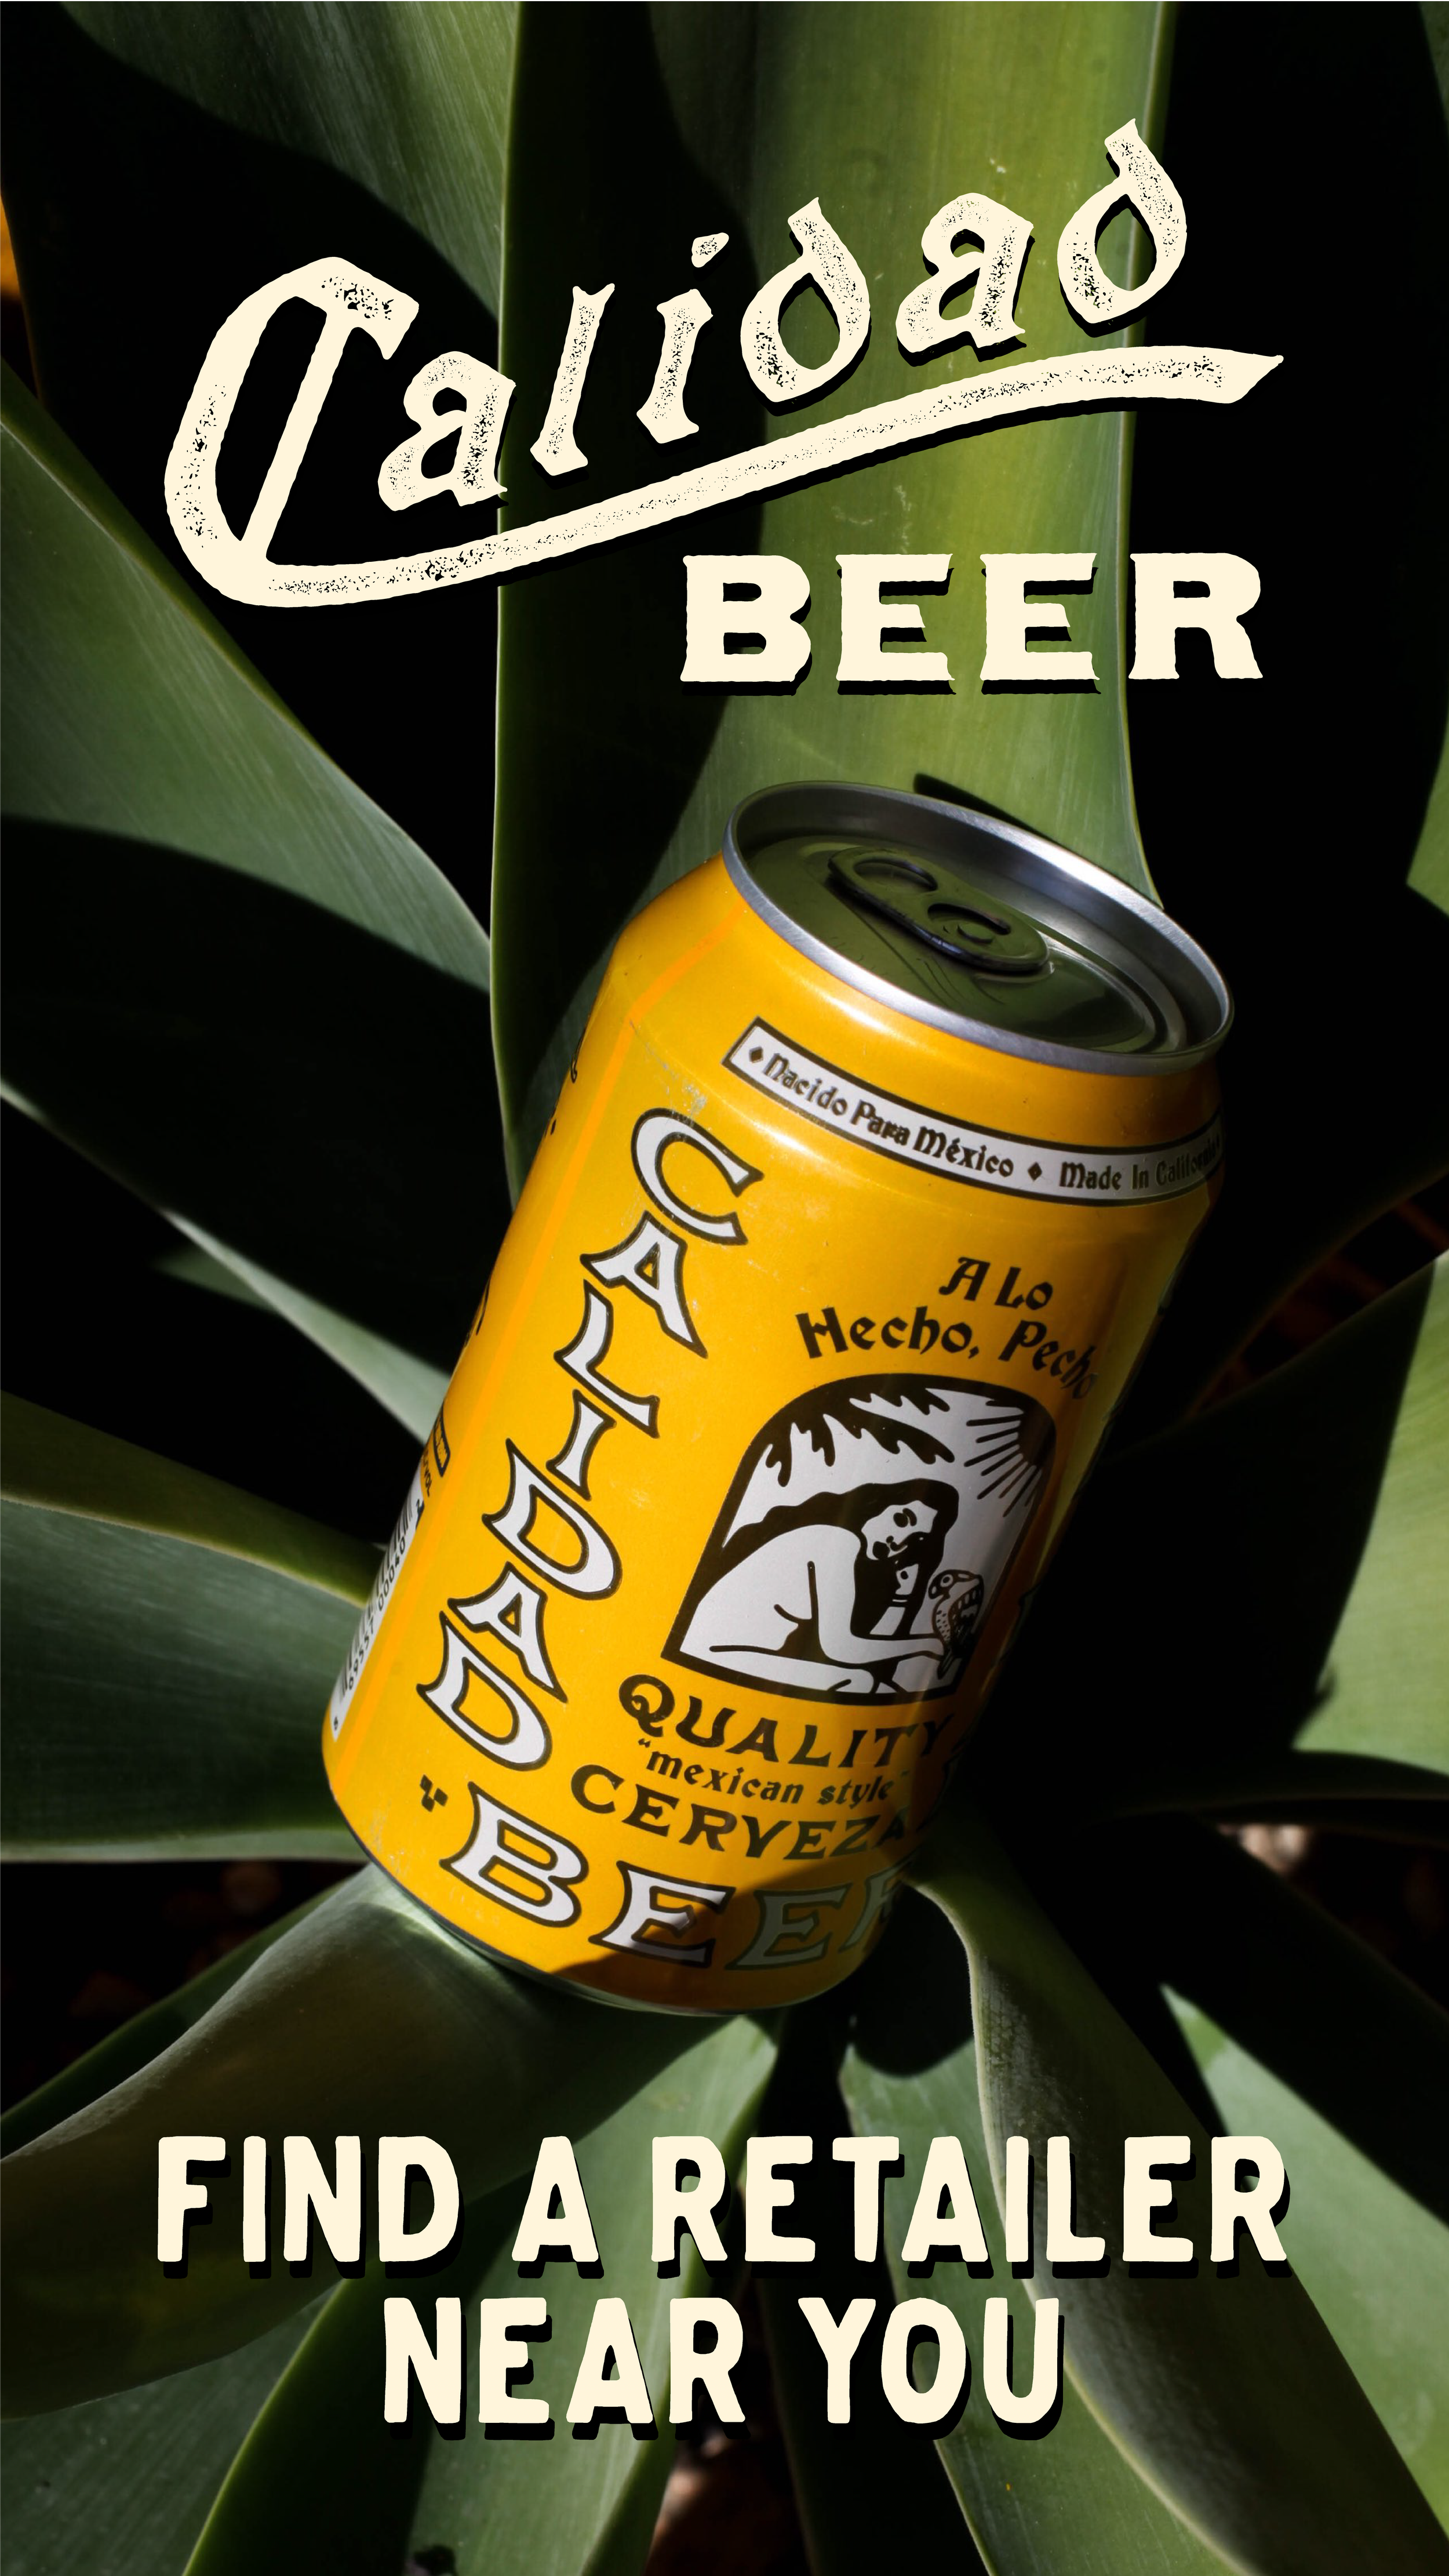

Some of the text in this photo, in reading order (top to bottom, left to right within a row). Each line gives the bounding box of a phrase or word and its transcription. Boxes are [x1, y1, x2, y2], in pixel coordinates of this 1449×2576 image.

[763, 1053, 1014, 1178] Nacido Para México
[1059, 1161, 1122, 1190] Made
[1132, 1164, 1149, 1189] In
[939, 1256, 1054, 1310] A Lo
[795, 1306, 1098, 1399] Hecho, Pecho
[416, 1107, 763, 1772] CALIDAD
[618, 1674, 954, 1768] QUALITY
[570, 1764, 915, 1861] CERVEZA
